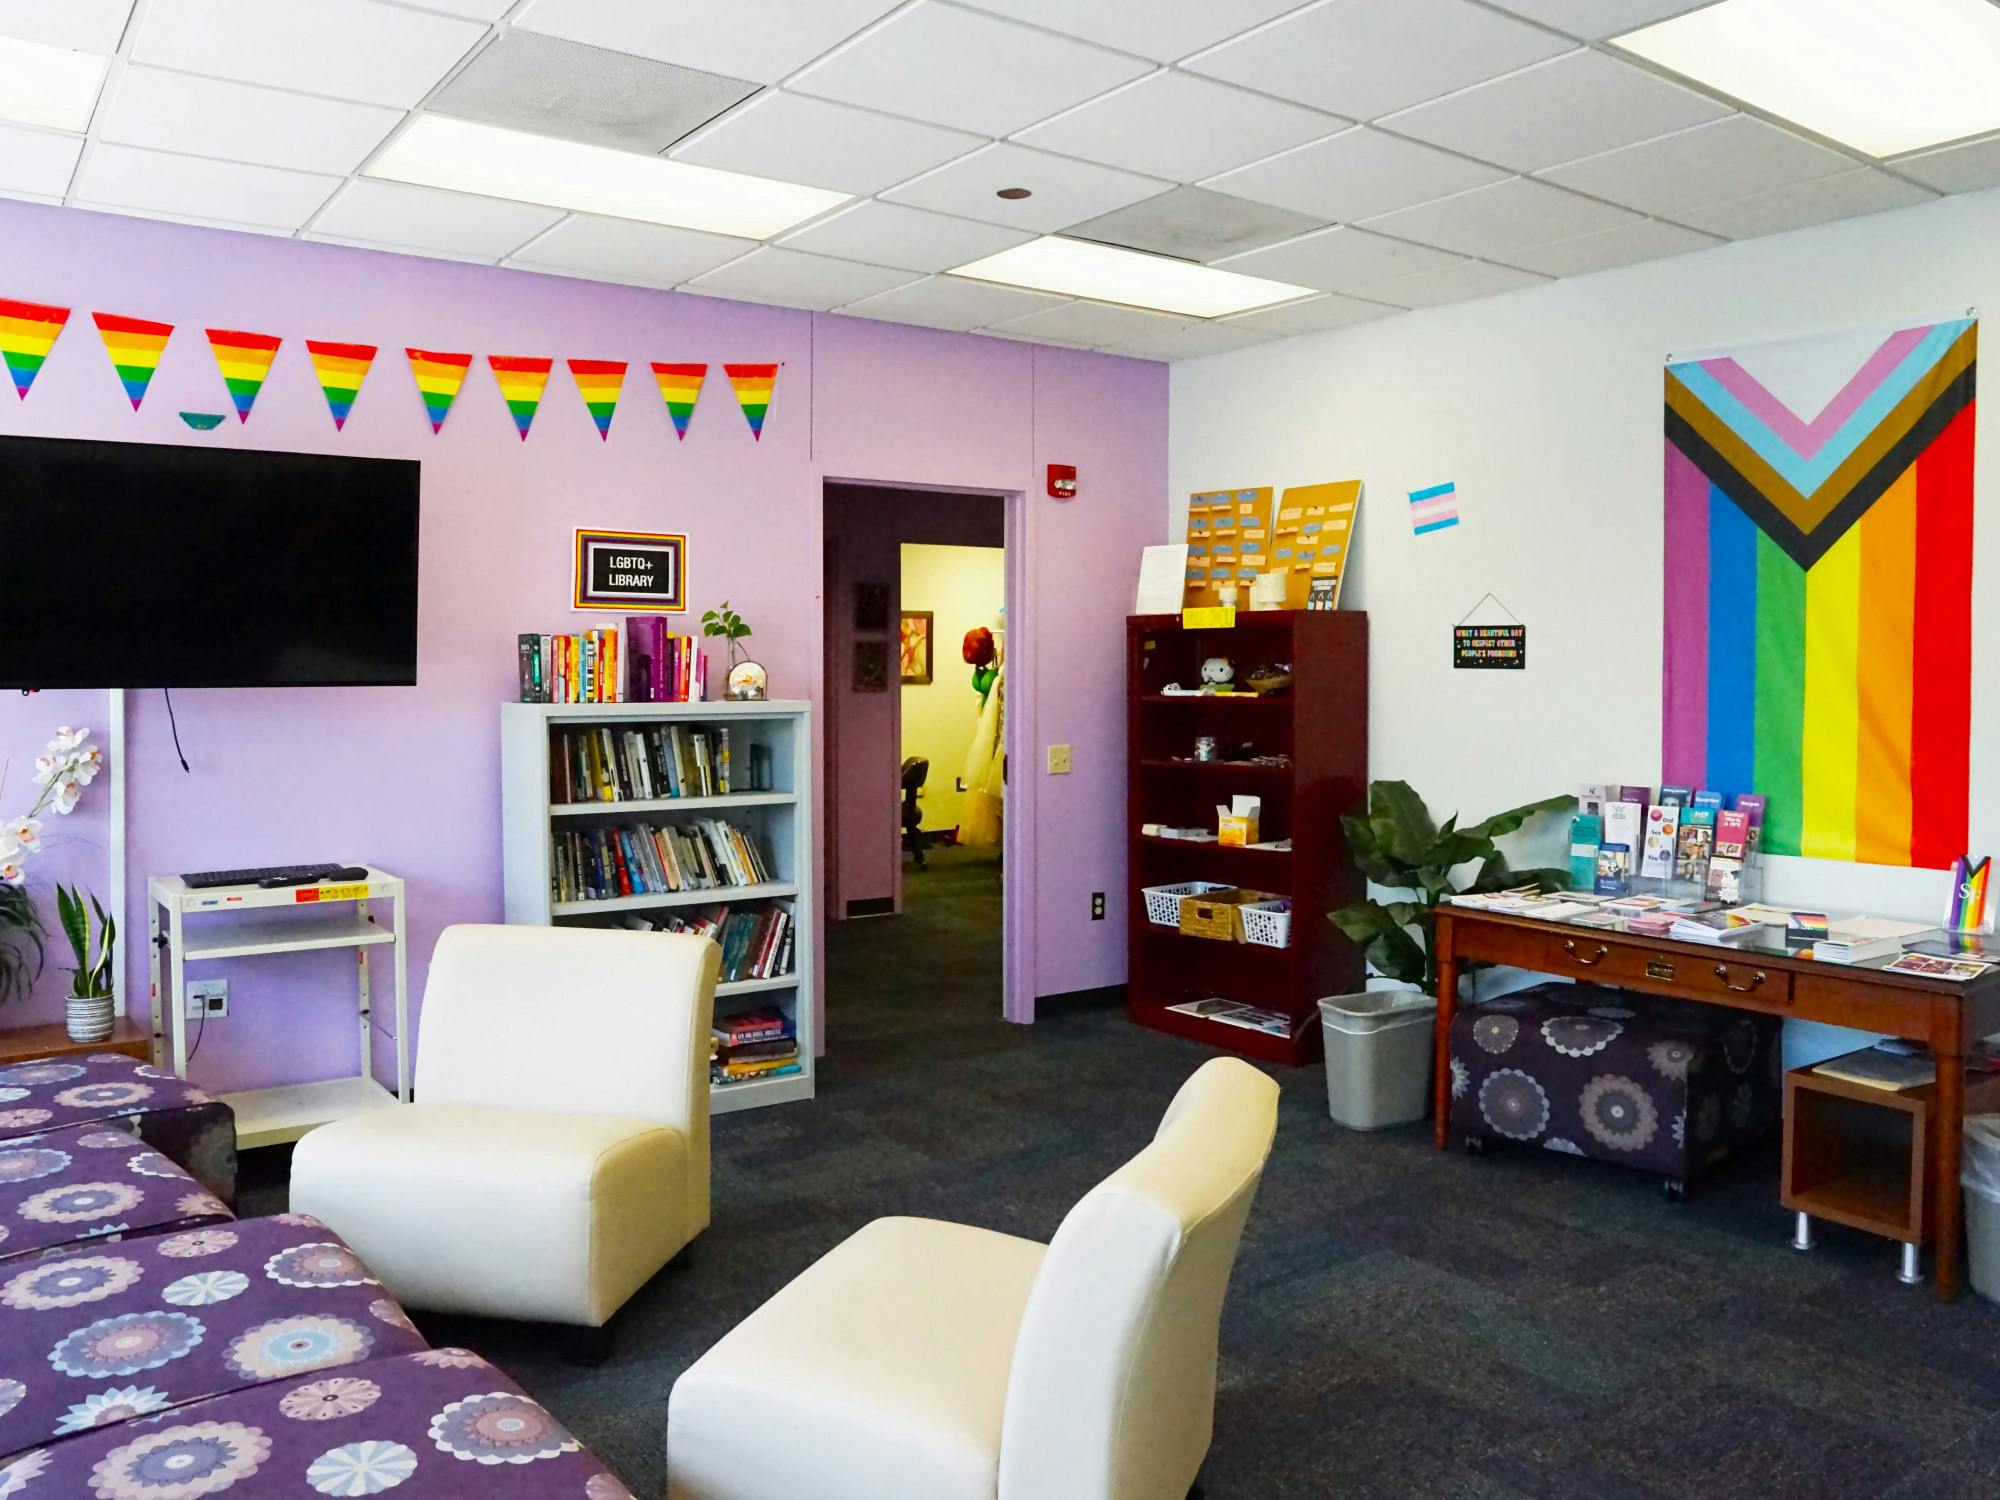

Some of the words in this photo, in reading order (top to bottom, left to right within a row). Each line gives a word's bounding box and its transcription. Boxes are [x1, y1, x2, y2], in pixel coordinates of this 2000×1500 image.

[609, 556, 654, 570] LGBTQ+
[608, 574, 654, 587] LIBRARY
[1455, 629, 1473, 637] WHAT
[1474, 629, 1479, 637] A
[1479, 629, 1510, 637] BEAUTIFUL
[1510, 629, 1523, 637] DAY
[1462, 639, 1471, 647] TO
[1472, 639, 1495, 647] RESPECT
